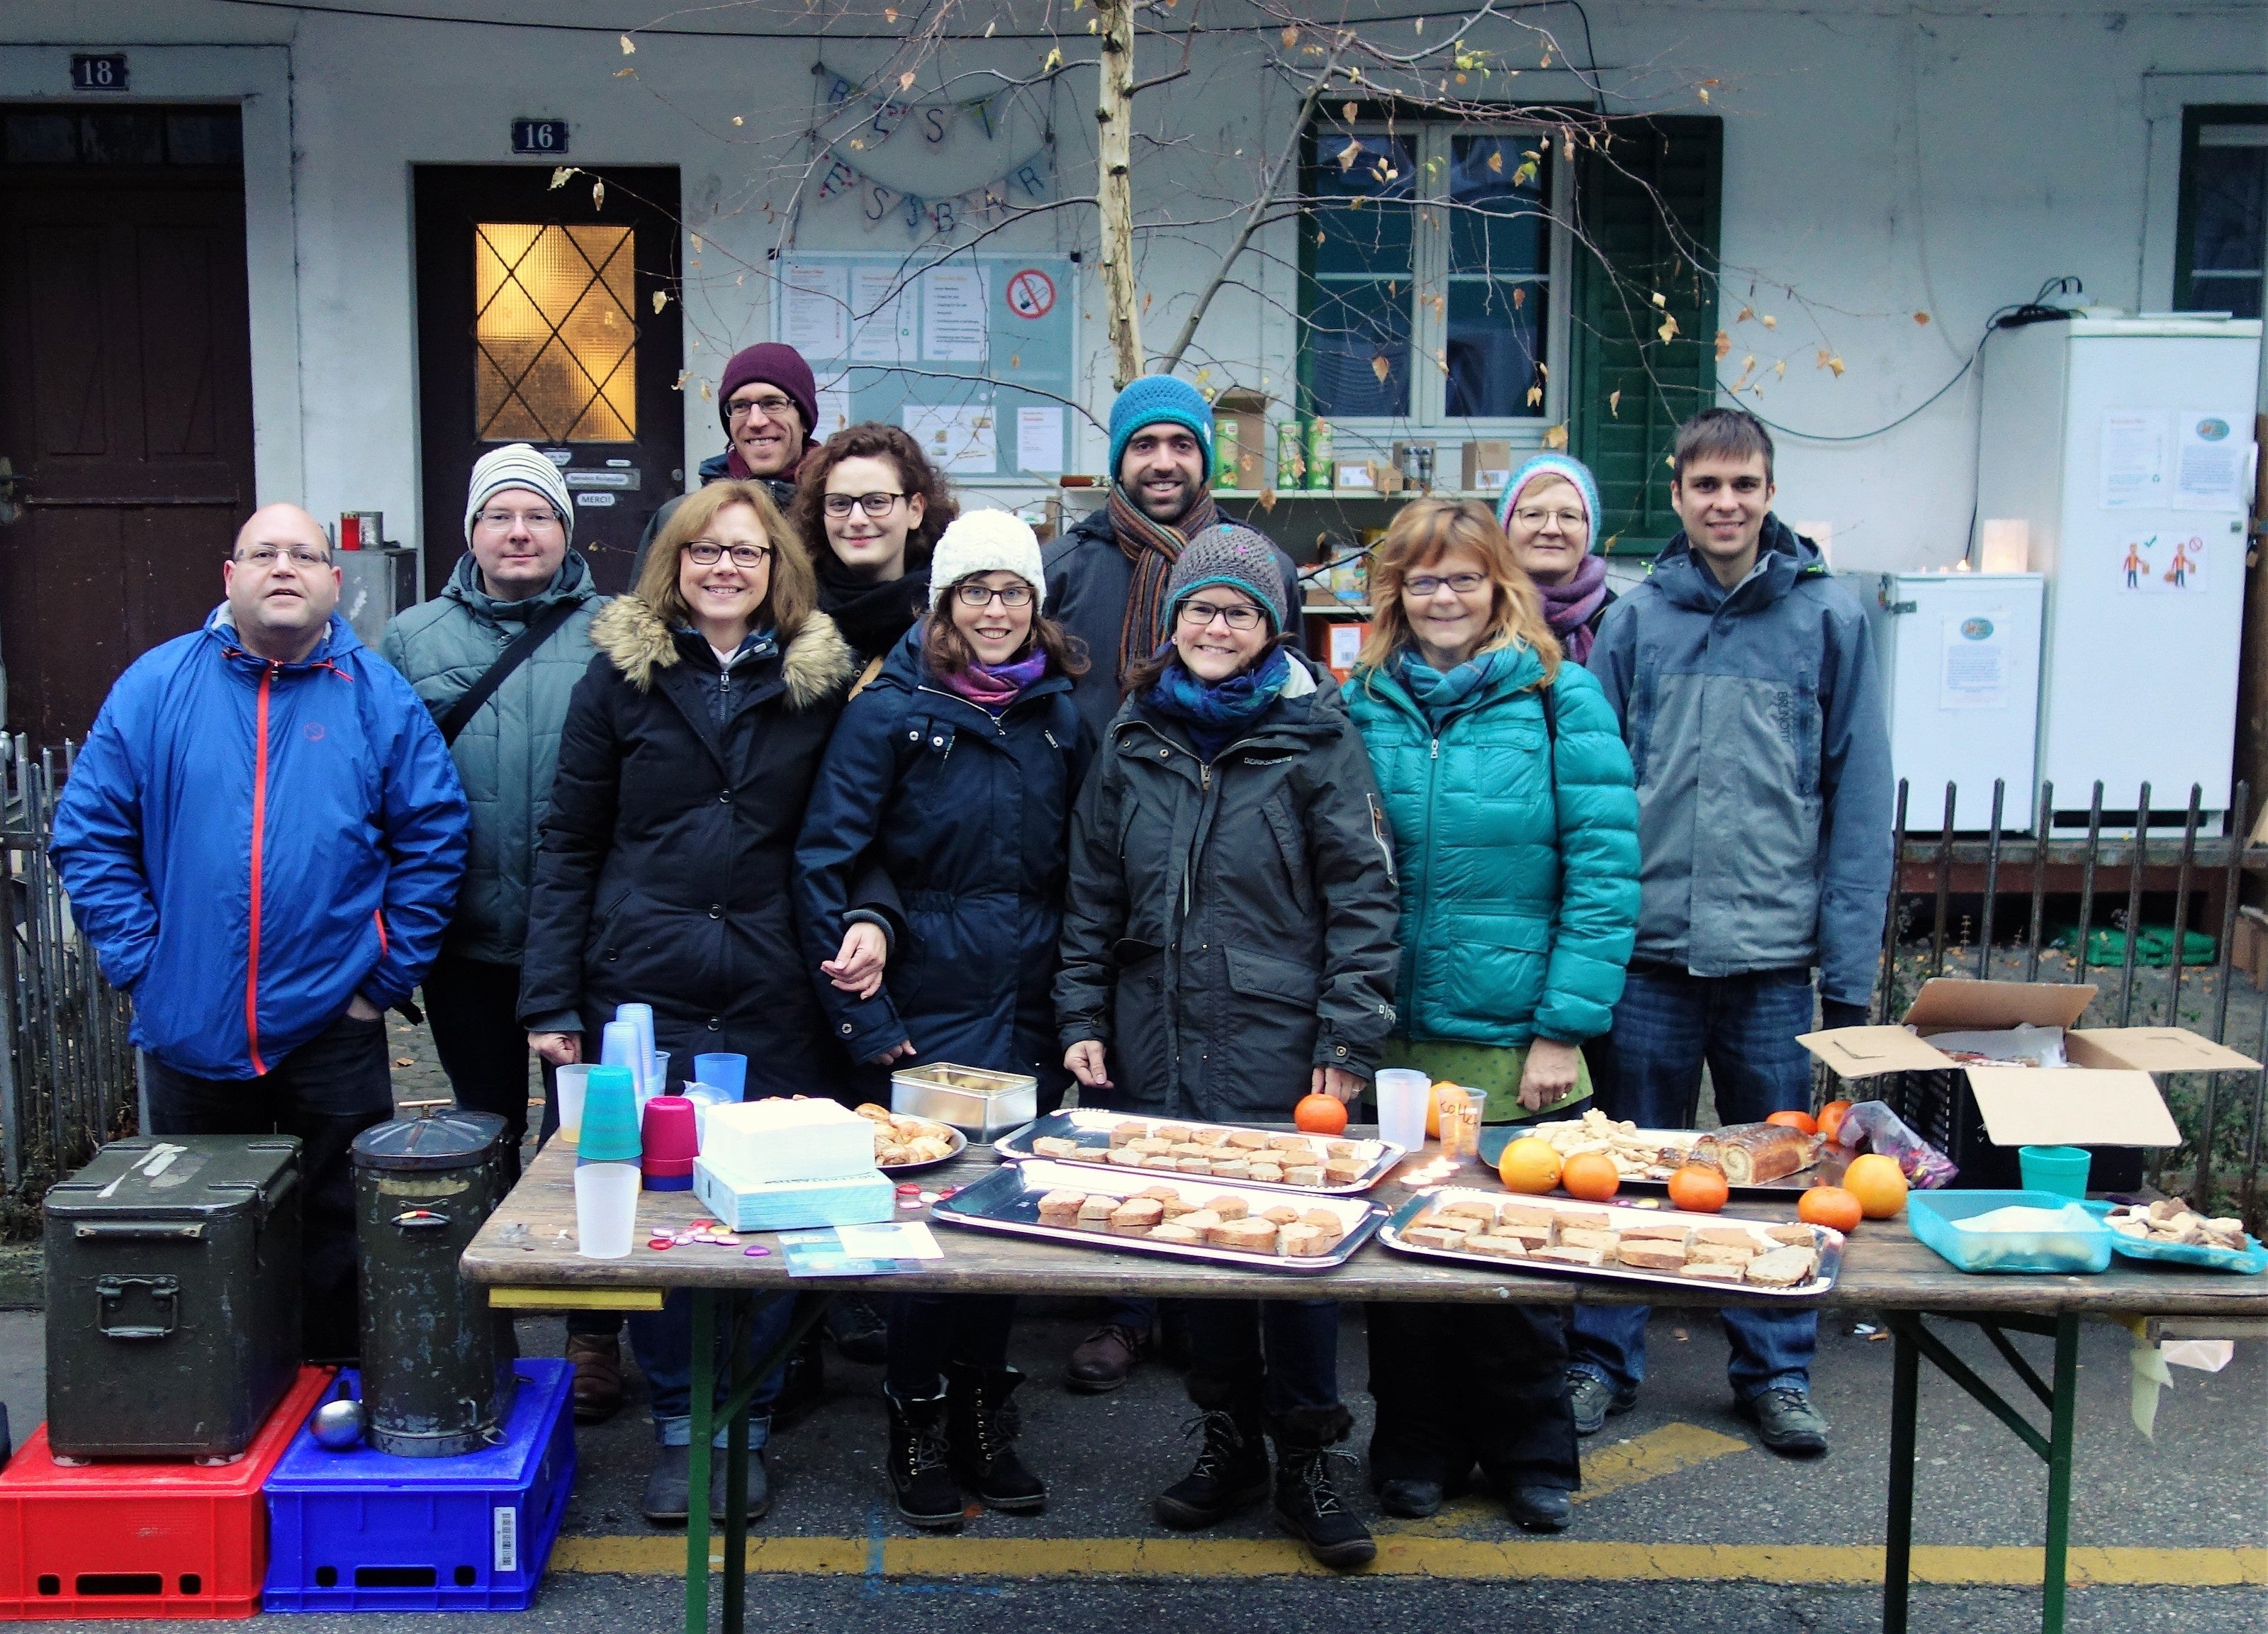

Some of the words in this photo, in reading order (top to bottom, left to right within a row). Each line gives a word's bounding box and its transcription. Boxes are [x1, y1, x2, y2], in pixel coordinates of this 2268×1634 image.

[84, 60, 113, 84] 18
[828, 77, 994, 142] REST
[526, 123, 553, 148] 16
